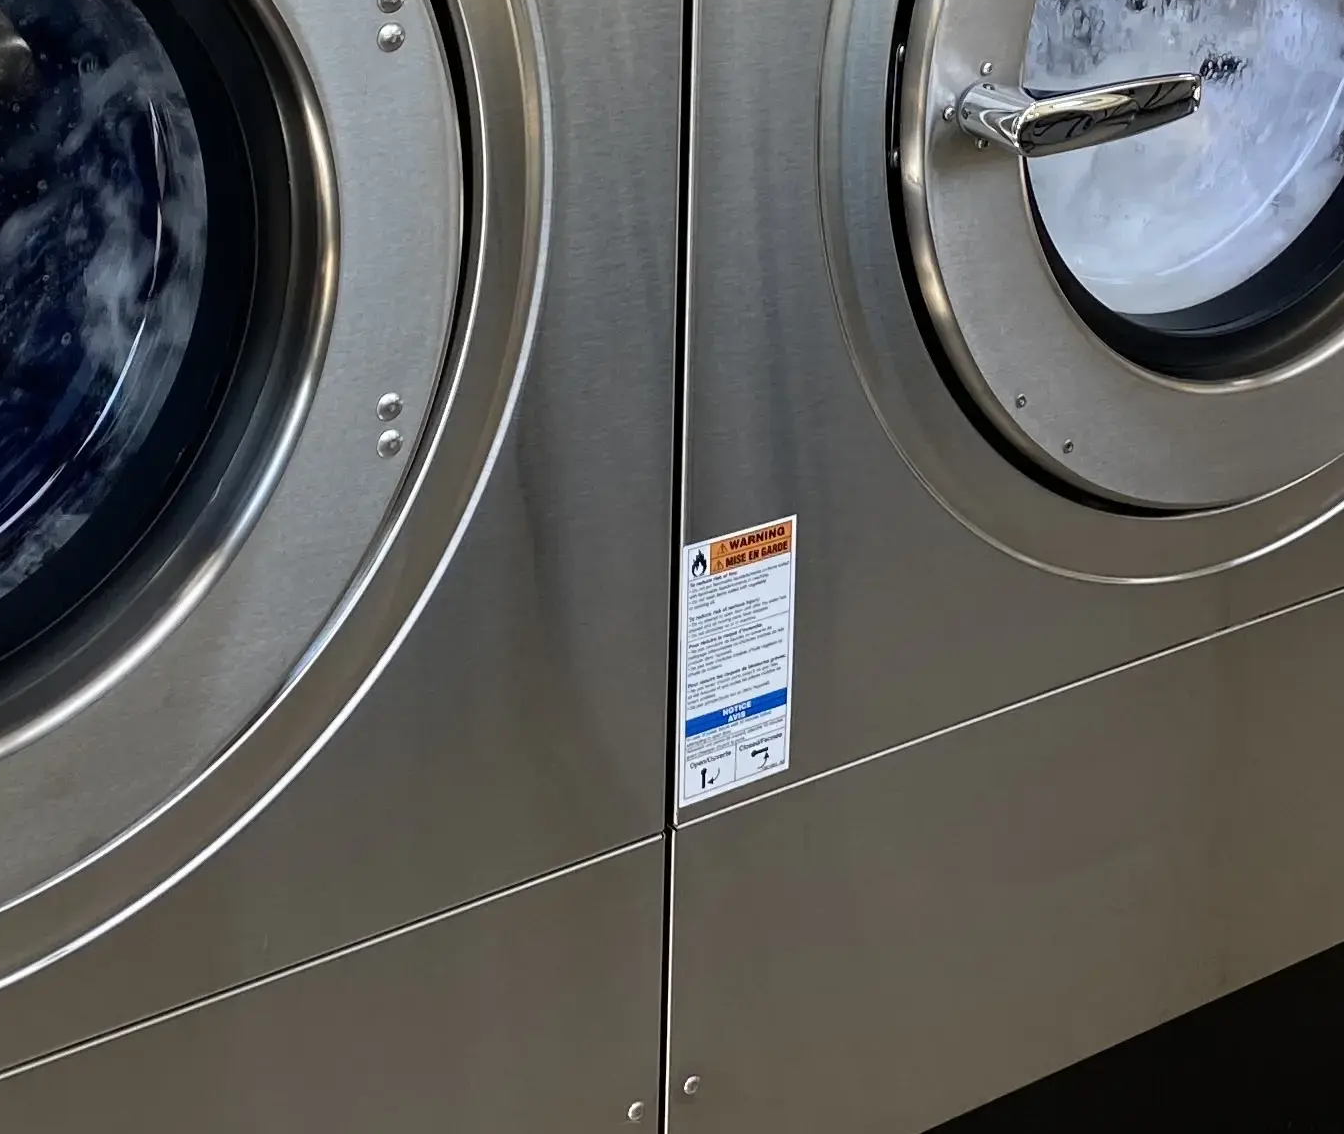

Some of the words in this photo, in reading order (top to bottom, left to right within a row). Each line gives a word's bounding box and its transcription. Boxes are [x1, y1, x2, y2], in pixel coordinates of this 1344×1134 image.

[728, 526, 785, 551] WARNING
[725, 554, 747, 568] MISE
[748, 550, 760, 561] EN
[760, 540, 788, 557] GARDE
[722, 701, 752, 716] NOTICE
[728, 711, 746, 722] AVIS
